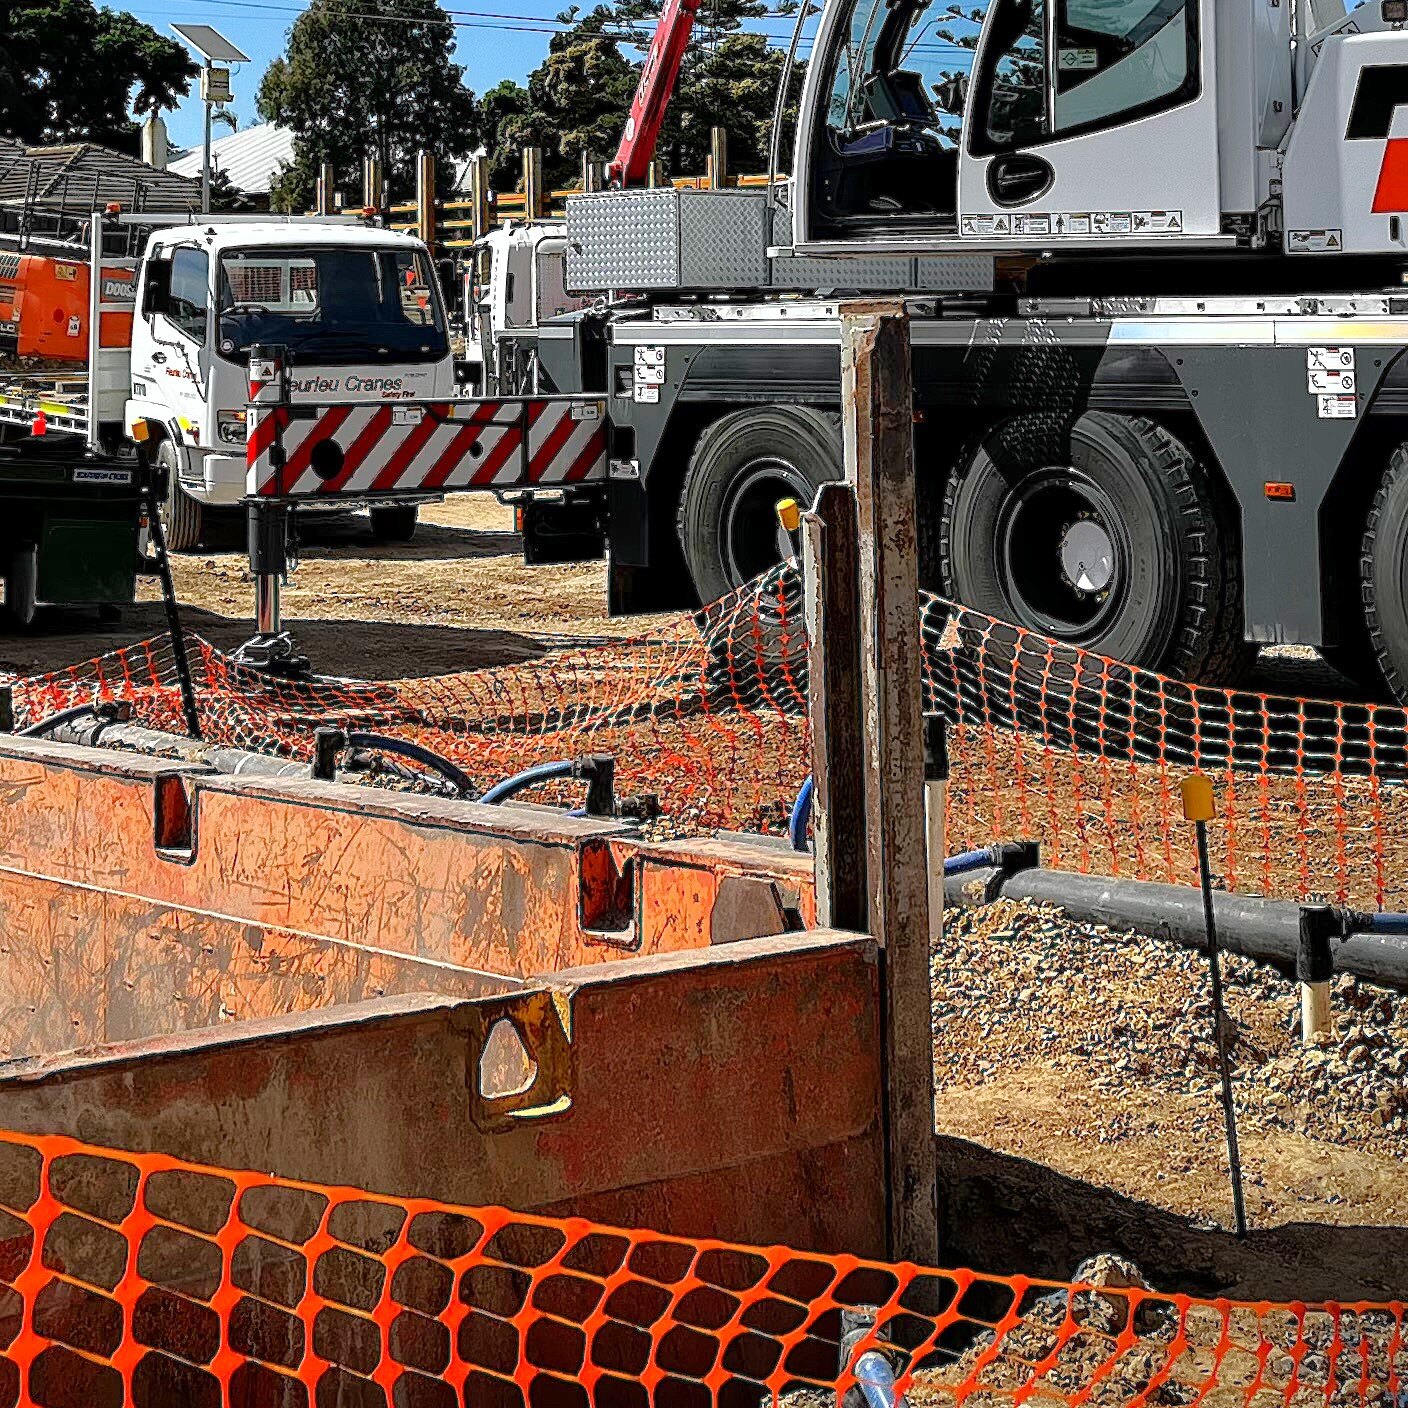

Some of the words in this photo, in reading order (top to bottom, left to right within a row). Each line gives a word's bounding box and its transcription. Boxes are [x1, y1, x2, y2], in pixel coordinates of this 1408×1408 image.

[104, 281, 138, 298] DOOS
[290, 375, 340, 393] eurieu
[344, 375, 403, 392] Cranes
